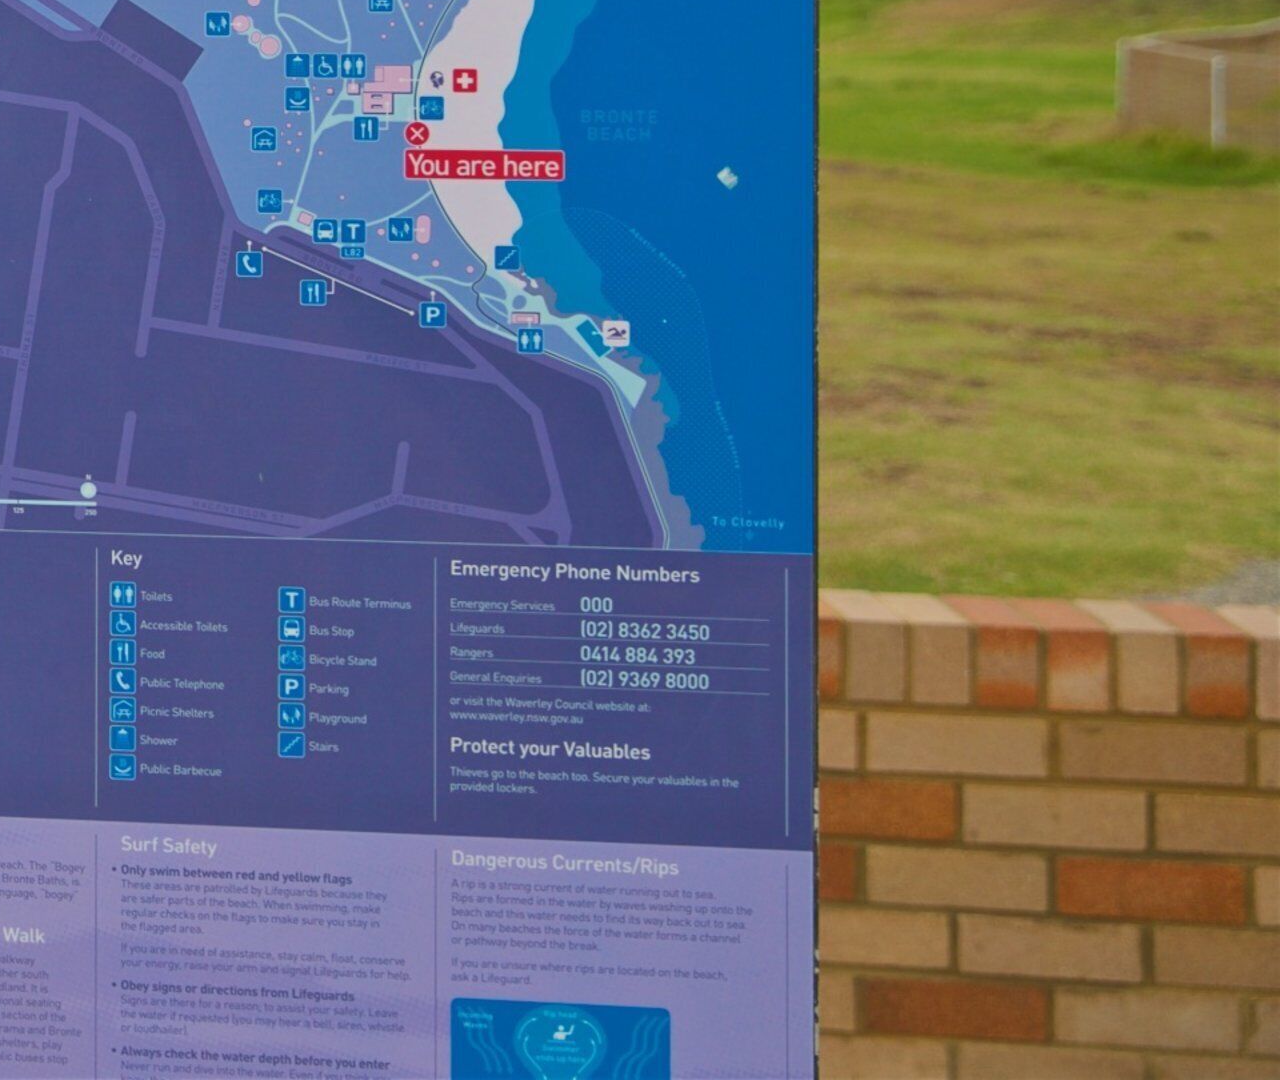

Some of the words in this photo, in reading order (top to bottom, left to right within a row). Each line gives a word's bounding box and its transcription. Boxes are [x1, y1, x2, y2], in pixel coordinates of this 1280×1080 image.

[580, 110, 658, 125] BRONTE
[587, 127, 650, 142] BEACH
[409, 155, 449, 176] You
[456, 160, 496, 177] are
[504, 156, 560, 178] here
[344, 248, 361, 256] L82
[712, 516, 726, 527] To
[731, 516, 784, 530] Clovelly
[111, 550, 142, 570] Key
[451, 560, 551, 582] Emergency
[556, 563, 611, 580] Phone
[617, 565, 700, 583] Numbers
[141, 591, 173, 602] Toilets
[309, 596, 330, 607] Bus
[332, 597, 362, 608] Route
[364, 598, 412, 610] Terminus
[450, 598, 510, 612] Emergency
[510, 600, 556, 613] Services
[580, 597, 613, 613] 000
[140, 620, 193, 631] Accessible
[196, 621, 228, 632] Toilets
[309, 625, 330, 636] Bus
[331, 626, 355, 639] Stop
[450, 623, 505, 635] Lifeguards
[581, 620, 613, 639] (02)
[618, 623, 661, 639] 8362
[666, 624, 710, 641] 3450
[140, 648, 165, 659] Food
[309, 654, 345, 667] Bicycle
[347, 656, 377, 667] Stand
[450, 647, 494, 660] Rangers
[580, 646, 620, 662] 0414
[625, 647, 658, 663] 884
[663, 648, 695, 665] 393
[140, 677, 171, 688] Public
[173, 678, 225, 691] Telephone
[450, 671, 490, 685] General
[493, 672, 542, 686] Enquiries
[581, 670, 613, 688] (02)
[618, 671, 660, 688] 9369
[666, 673, 709, 690] 8000
[309, 684, 349, 697] Parking
[449, 698, 461, 706] or
[463, 698, 483, 706] visit
[486, 697, 503, 707] the
[505, 698, 553, 710] Waverley
[554, 699, 594, 710] Council
[595, 702, 636, 712] website
[140, 706, 170, 717] Picnic
[172, 707, 215, 719] Shelters
[309, 713, 367, 726] Playground
[449, 712, 584, 725] www.waverley.nsw.gov.au
[140, 735, 178, 746] Shower
[309, 742, 339, 752] Stairs
[450, 737, 515, 755] Protect
[519, 744, 560, 759] your
[563, 742, 651, 760] Valuables
[140, 764, 171, 775] Public
[173, 765, 222, 777] Barbecue
[121, 836, 158, 852] Surf
[163, 838, 217, 856] Safety
[29, 860, 47, 871] The
[452, 850, 548, 871] Dangerous
[552, 854, 679, 877] Currents/Rips
[121, 865, 147, 878] Only
[149, 867, 180, 877] swim
[183, 867, 233, 880] between
[235, 870, 255, 881] red
[258, 872, 280, 882] and
[282, 872, 321, 884] yellow
[323, 873, 353, 887] flags
[3, 927, 44, 943] Walk
[120, 980, 149, 994] Obey
[152, 982, 182, 995] signs
[185, 985, 198, 994] or
[200, 984, 258, 997] directions
[260, 987, 289, 998] from
[292, 989, 355, 1002] Lifeguards
[120, 1046, 162, 1060] Always
[164, 1049, 198, 1060] check
[201, 1050, 219, 1062] the
[222, 1053, 256, 1063] water
[258, 1053, 292, 1066] depth
[294, 1055, 333, 1068] before
[335, 1059, 356, 1069] you
[358, 1060, 391, 1070] enter
